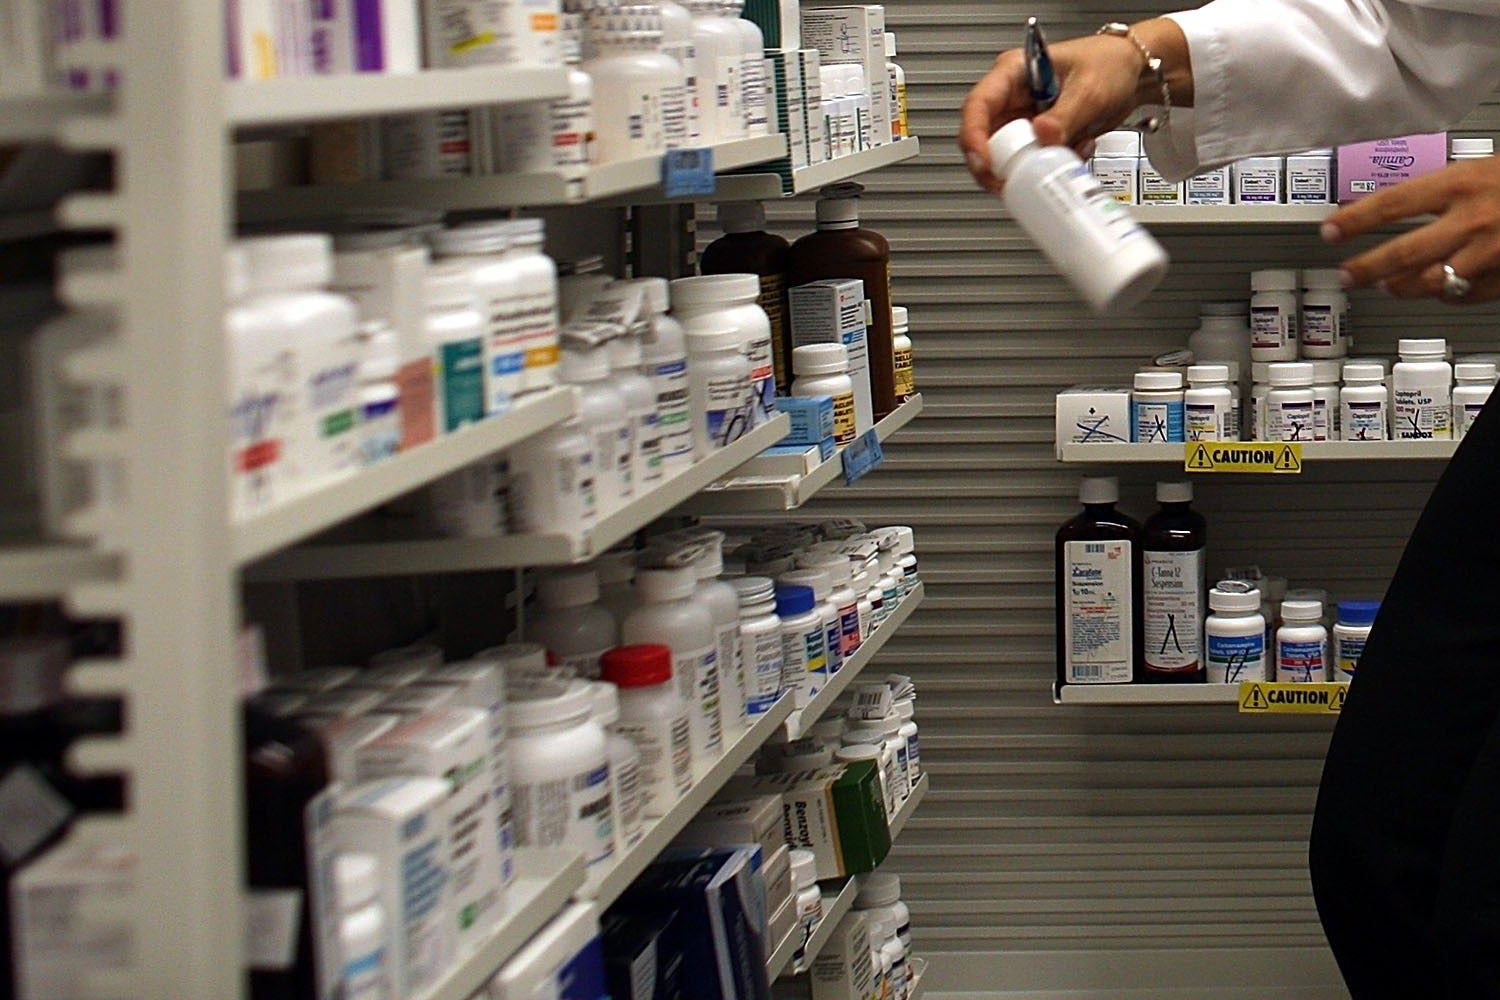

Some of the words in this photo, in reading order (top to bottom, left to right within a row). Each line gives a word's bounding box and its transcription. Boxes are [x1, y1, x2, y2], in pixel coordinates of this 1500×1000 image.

[1213, 450, 1274, 464] CAUTION
[1267, 690, 1329, 704] CAUTION
[796, 801, 814, 847] Benzoyl
